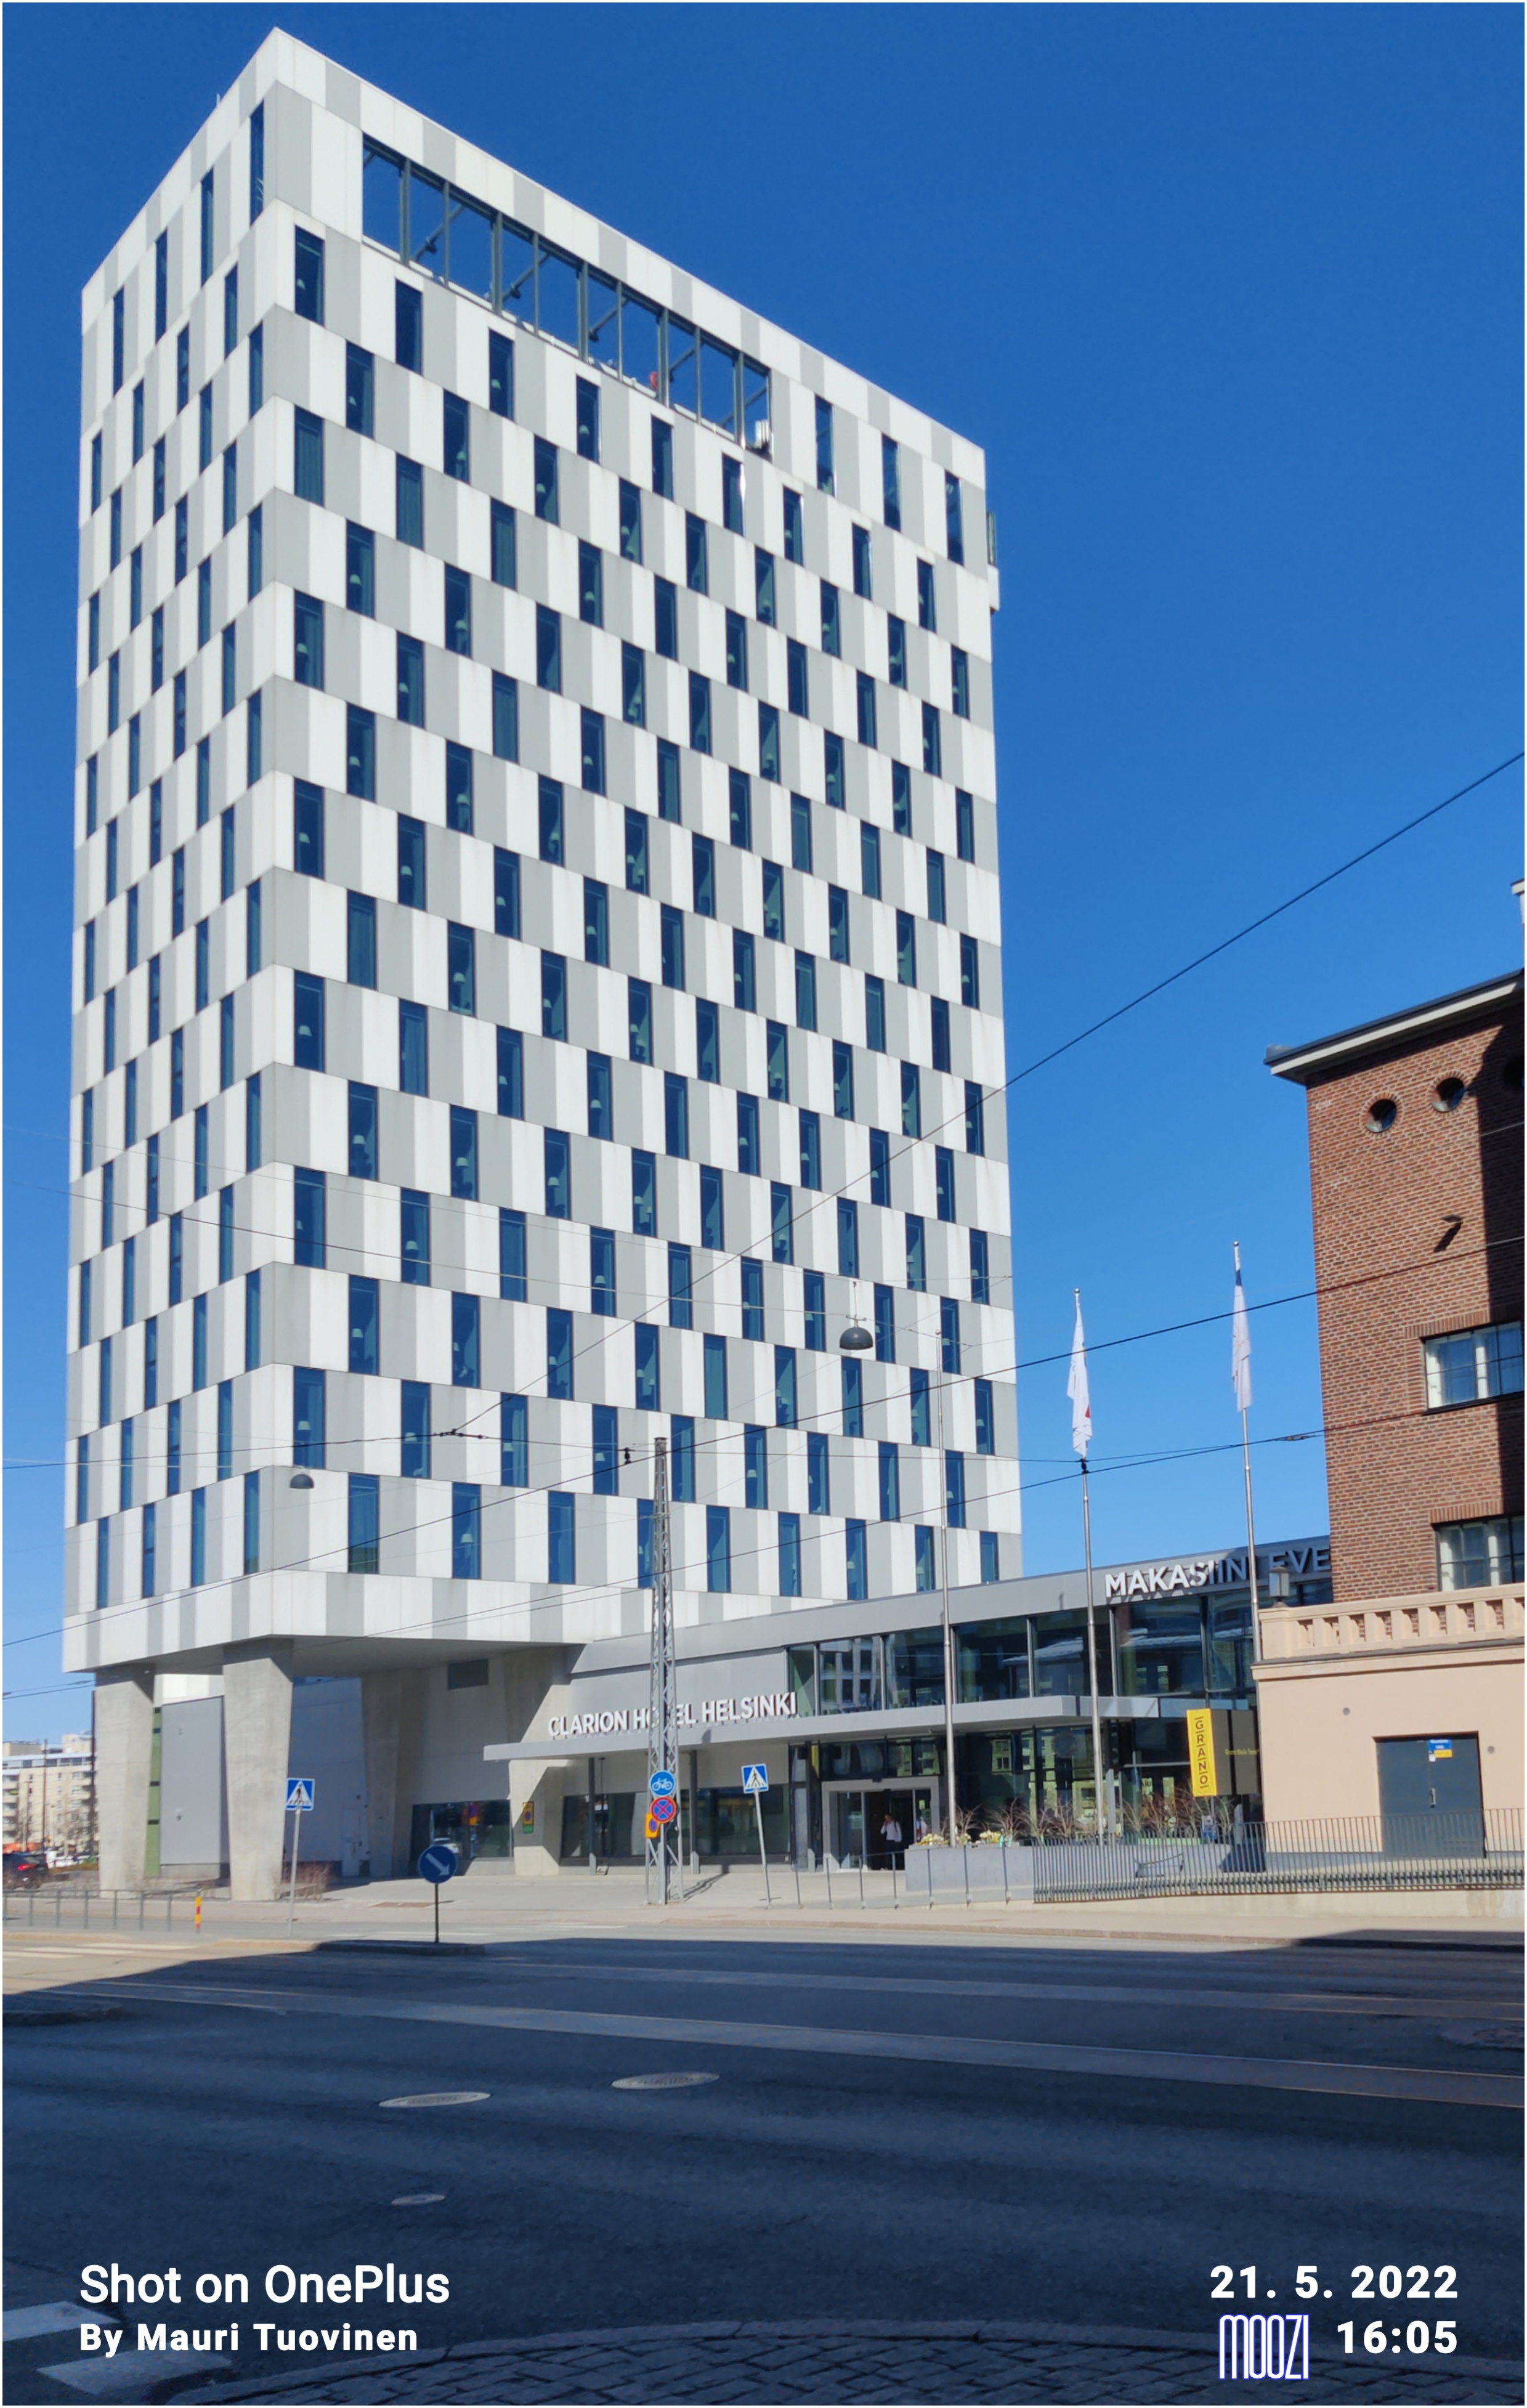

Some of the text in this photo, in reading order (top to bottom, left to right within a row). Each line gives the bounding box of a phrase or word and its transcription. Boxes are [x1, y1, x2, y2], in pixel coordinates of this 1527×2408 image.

[1104, 1555, 1255, 1598] MAKASIIN
[547, 1692, 796, 1737] CLARION HOEL HELSINKI
[1194, 1719, 1209, 1785] GRANO
